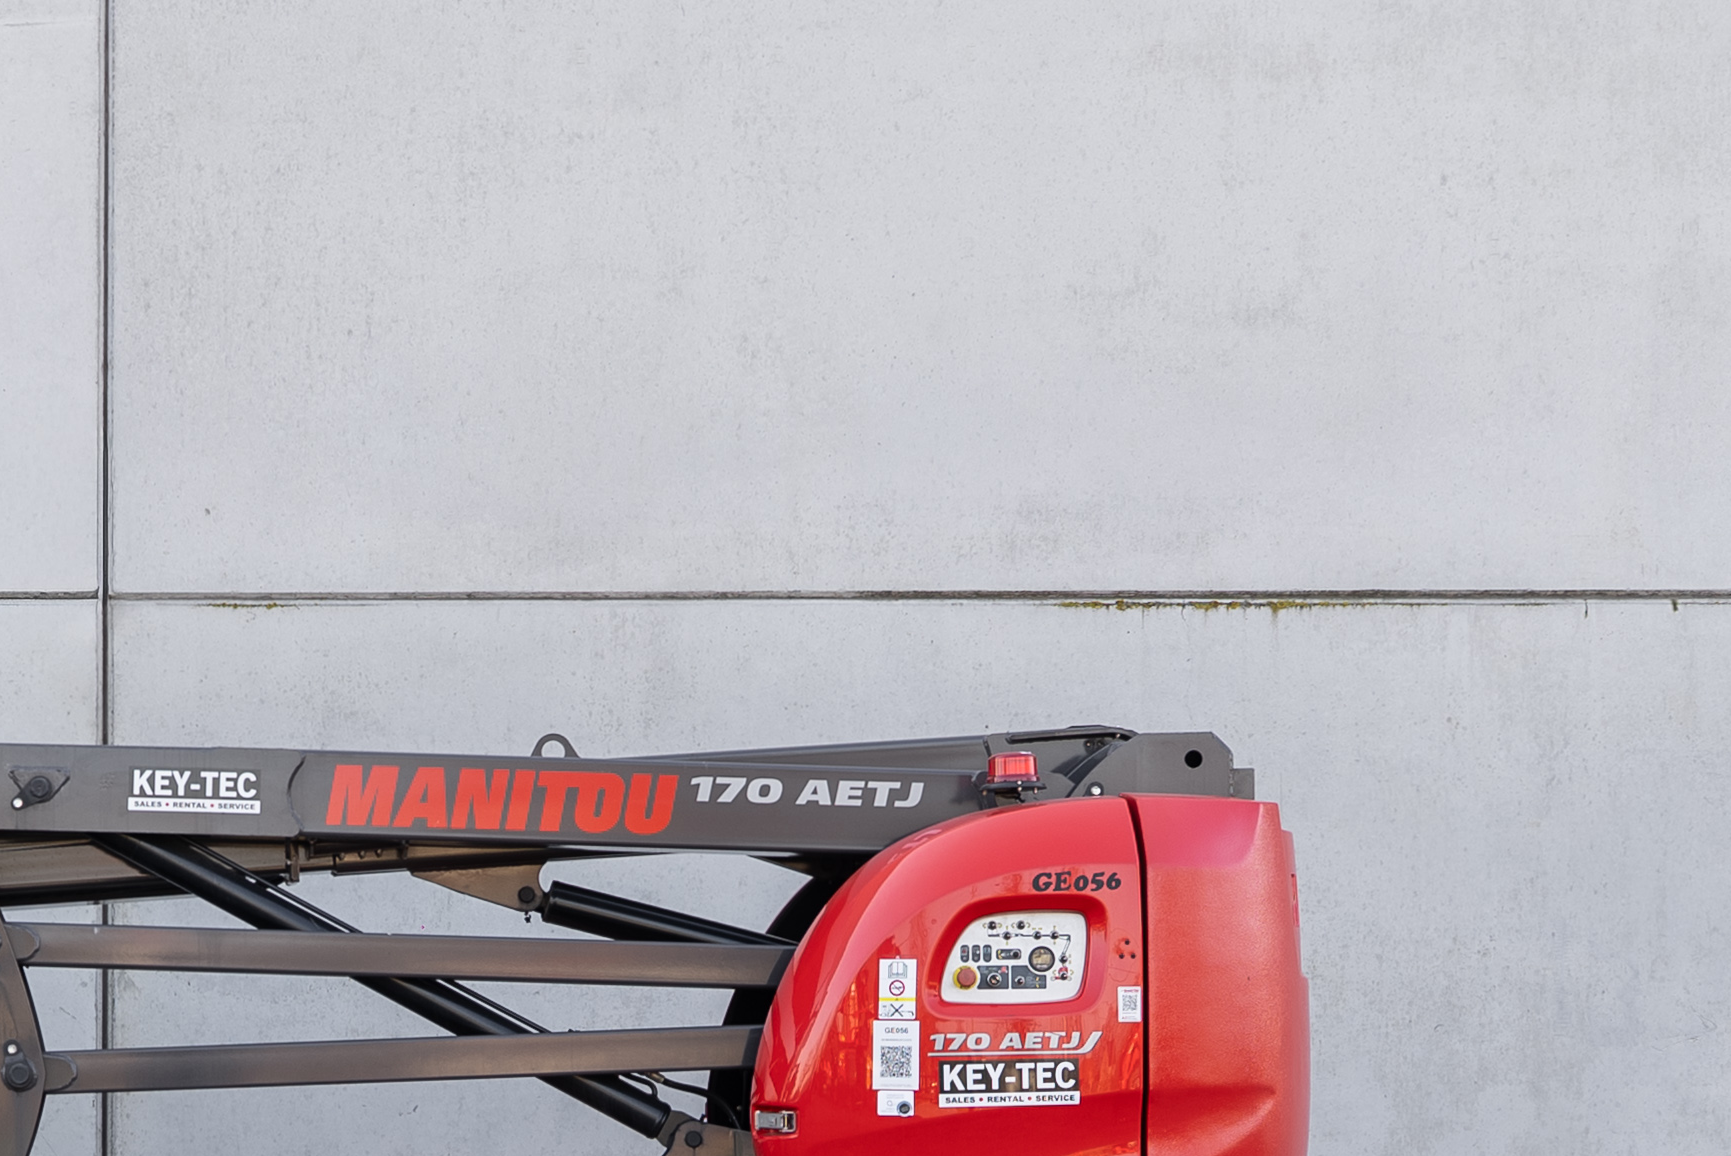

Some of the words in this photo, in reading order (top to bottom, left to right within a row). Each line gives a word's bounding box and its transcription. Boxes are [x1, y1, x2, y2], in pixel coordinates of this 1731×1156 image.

[132, 769, 258, 799] KEY-TEC
[133, 800, 162, 808] SALES
[172, 801, 207, 809] RENTAL
[325, 764, 680, 836] MANITOU
[690, 776, 784, 804] 170
[795, 779, 925, 808] AETJ
[1032, 871, 1122, 892] GE056
[884, 1026, 909, 1034] GE056
[929, 1032, 991, 1051] 170
[999, 1031, 1081, 1050] AETJ
[942, 1061, 1076, 1091] KEY-TEC
[945, 1096, 976, 1104] SALES
[987, 1095, 1025, 1103] RENTAL
[1035, 1094, 1075, 1102] SERVICE
